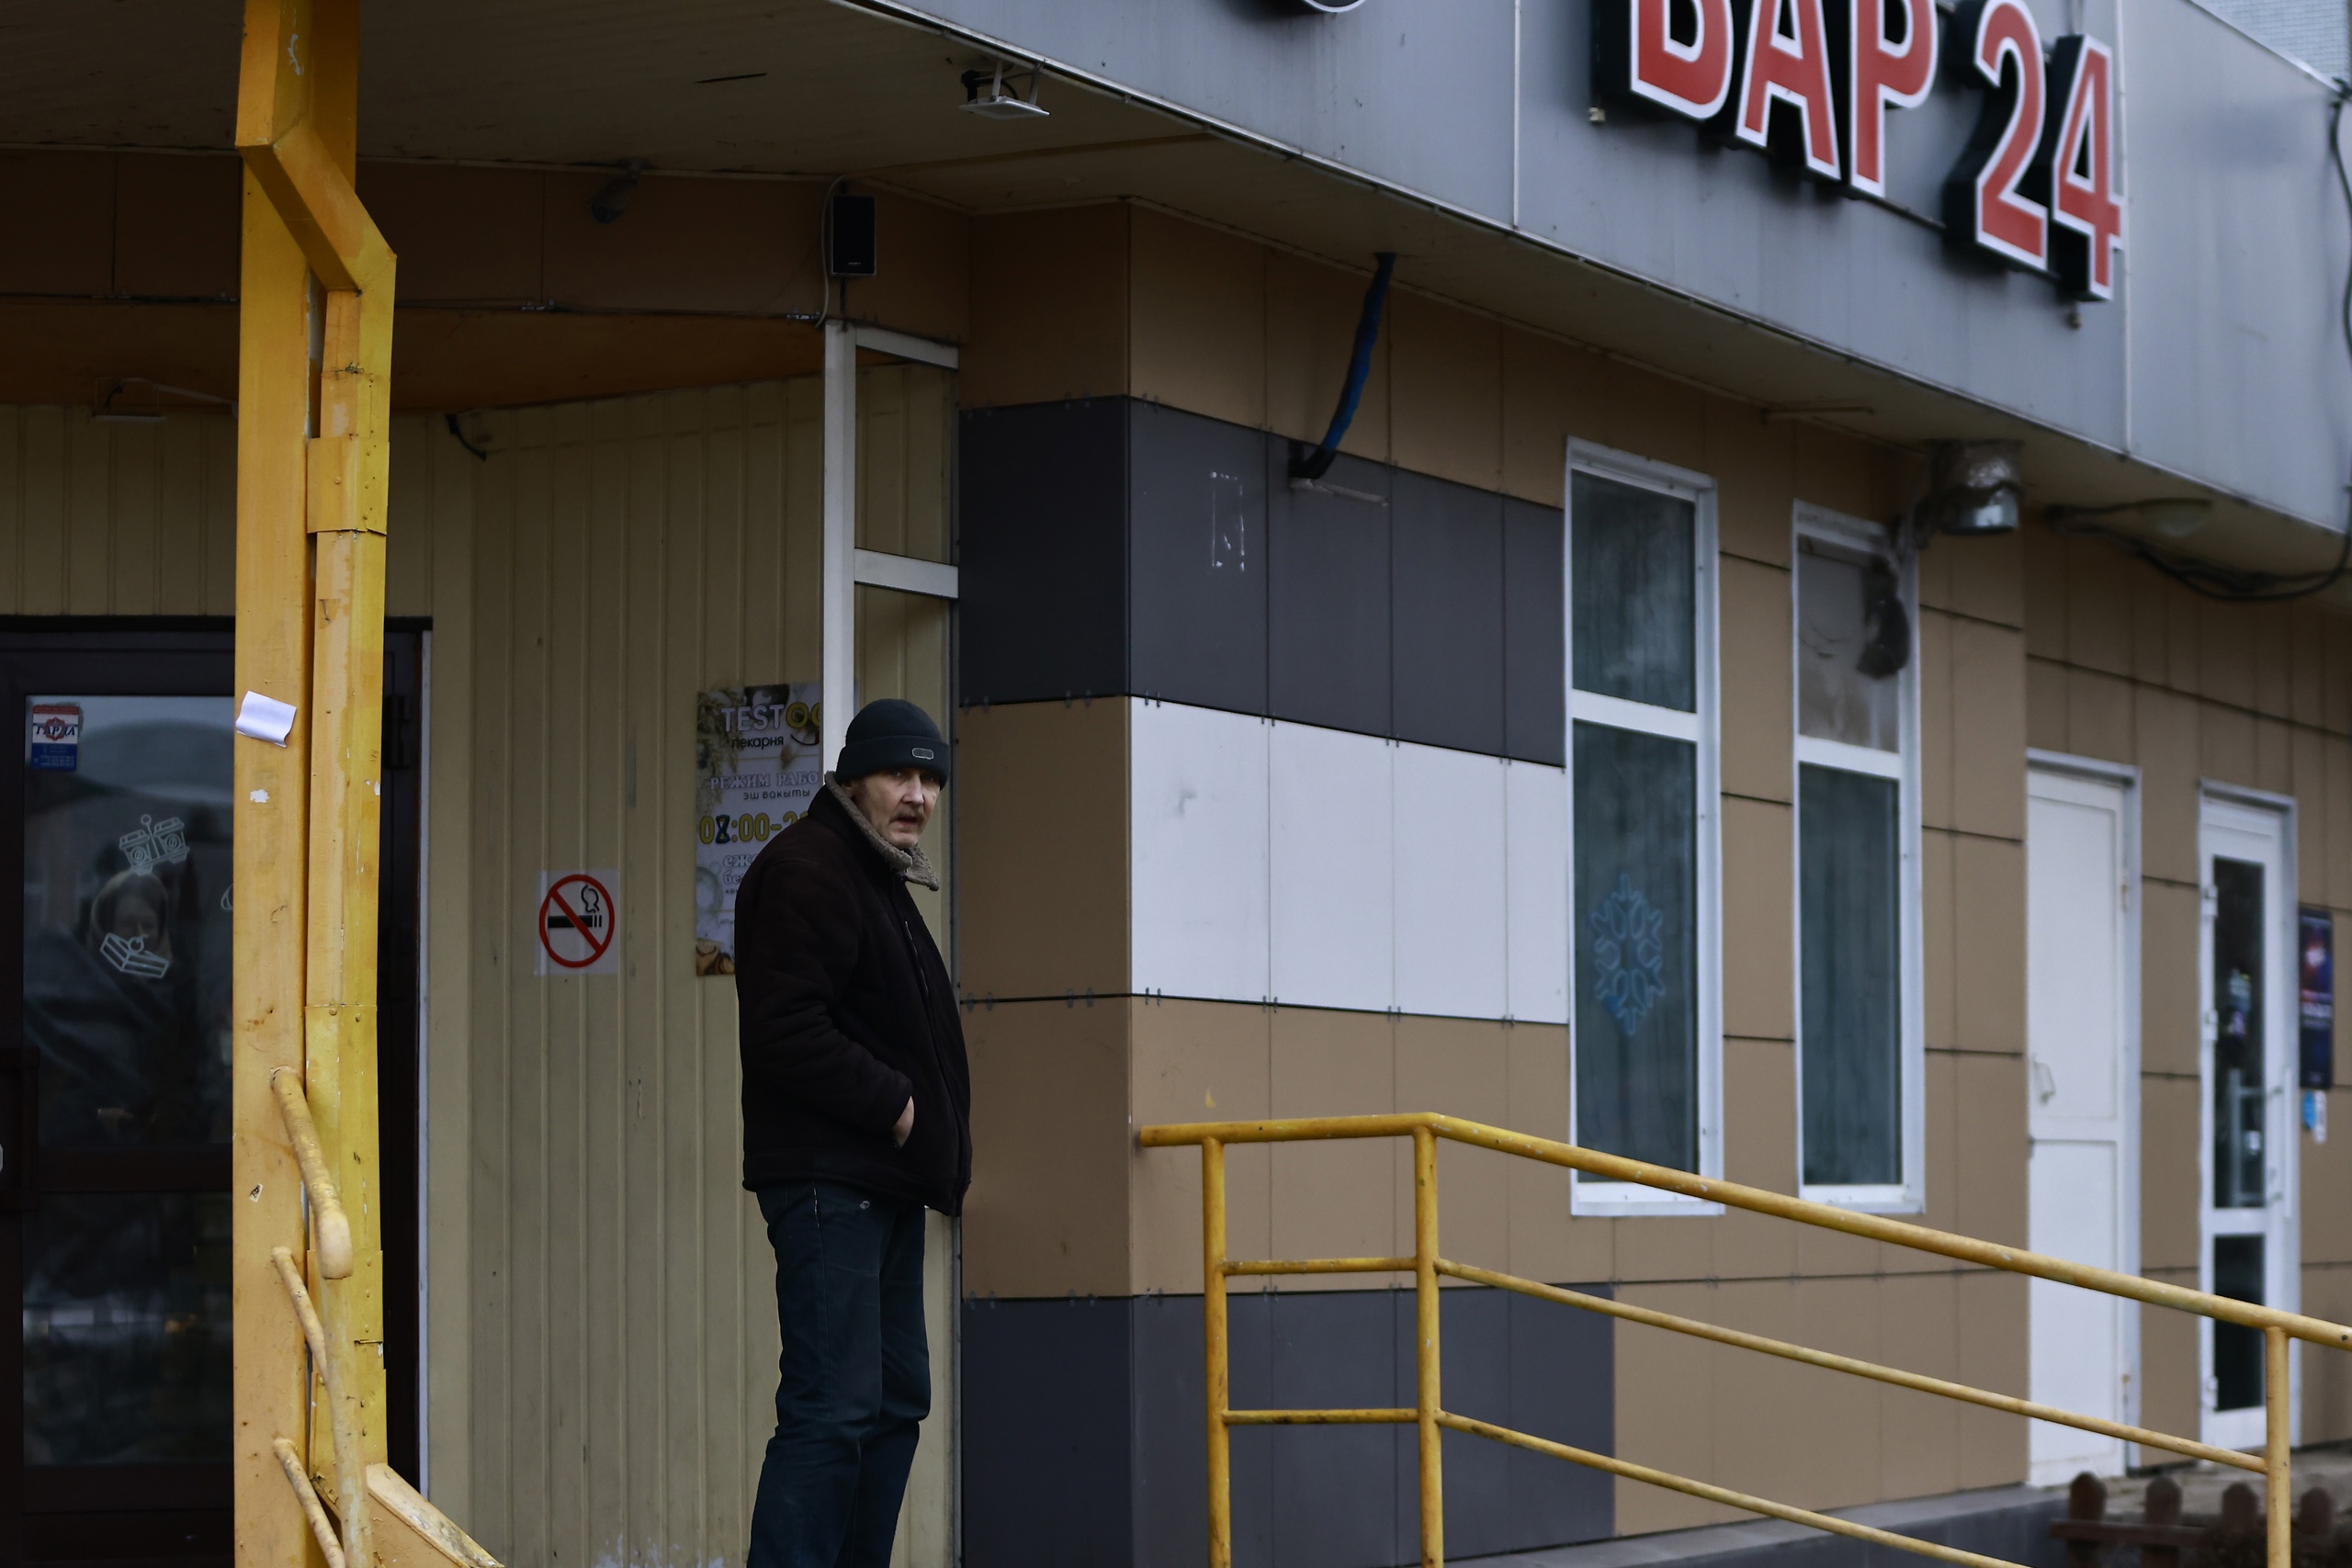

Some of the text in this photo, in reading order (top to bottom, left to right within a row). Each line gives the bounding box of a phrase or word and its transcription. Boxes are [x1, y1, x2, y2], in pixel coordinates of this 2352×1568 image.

[1973, 0, 2126, 300] 24
[731, 735, 785, 750] пекарня
[709, 773, 771, 790] РЕЖИМ
[743, 792, 760, 800] эш
